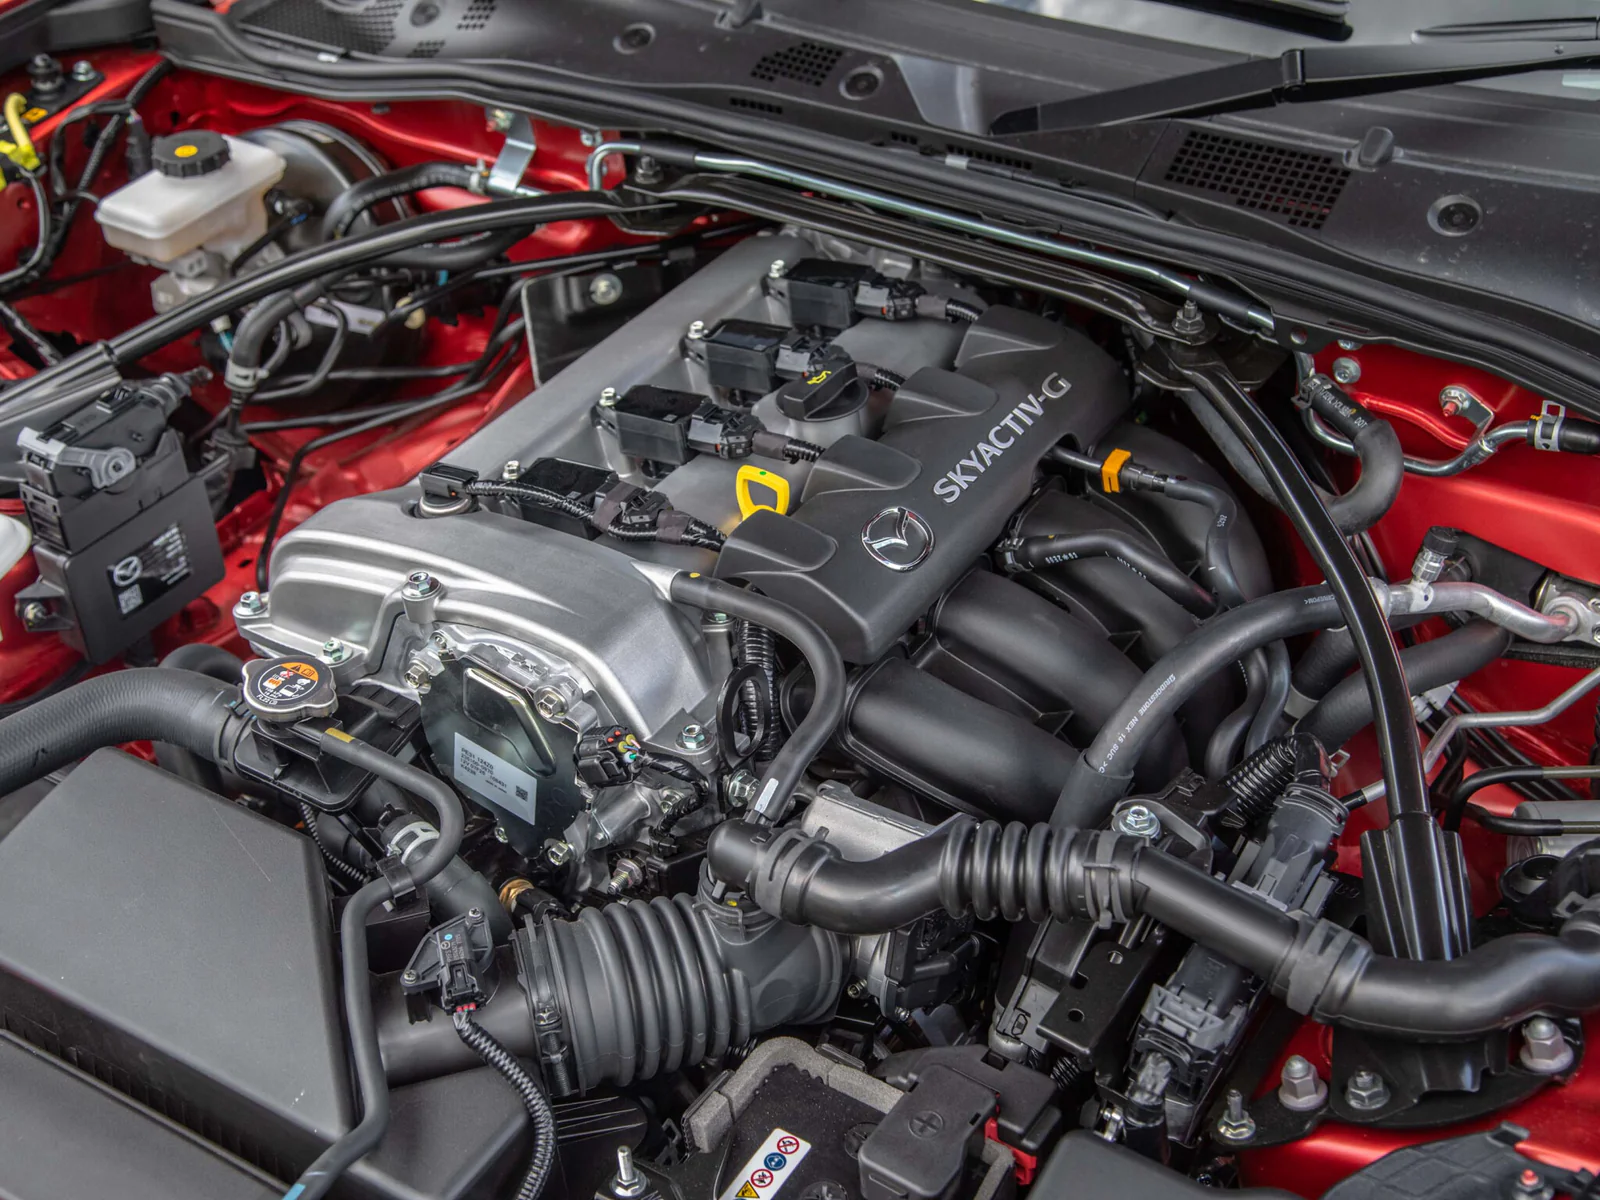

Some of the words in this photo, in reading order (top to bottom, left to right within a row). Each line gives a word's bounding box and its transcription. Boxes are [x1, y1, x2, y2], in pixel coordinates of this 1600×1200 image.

[933, 372, 1072, 503] SKYACTIV-G
[1138, 673, 1176, 716] BRIDGESTONE
[1125, 716, 1139, 733] NEX
[1106, 743, 1120, 761] SUC
